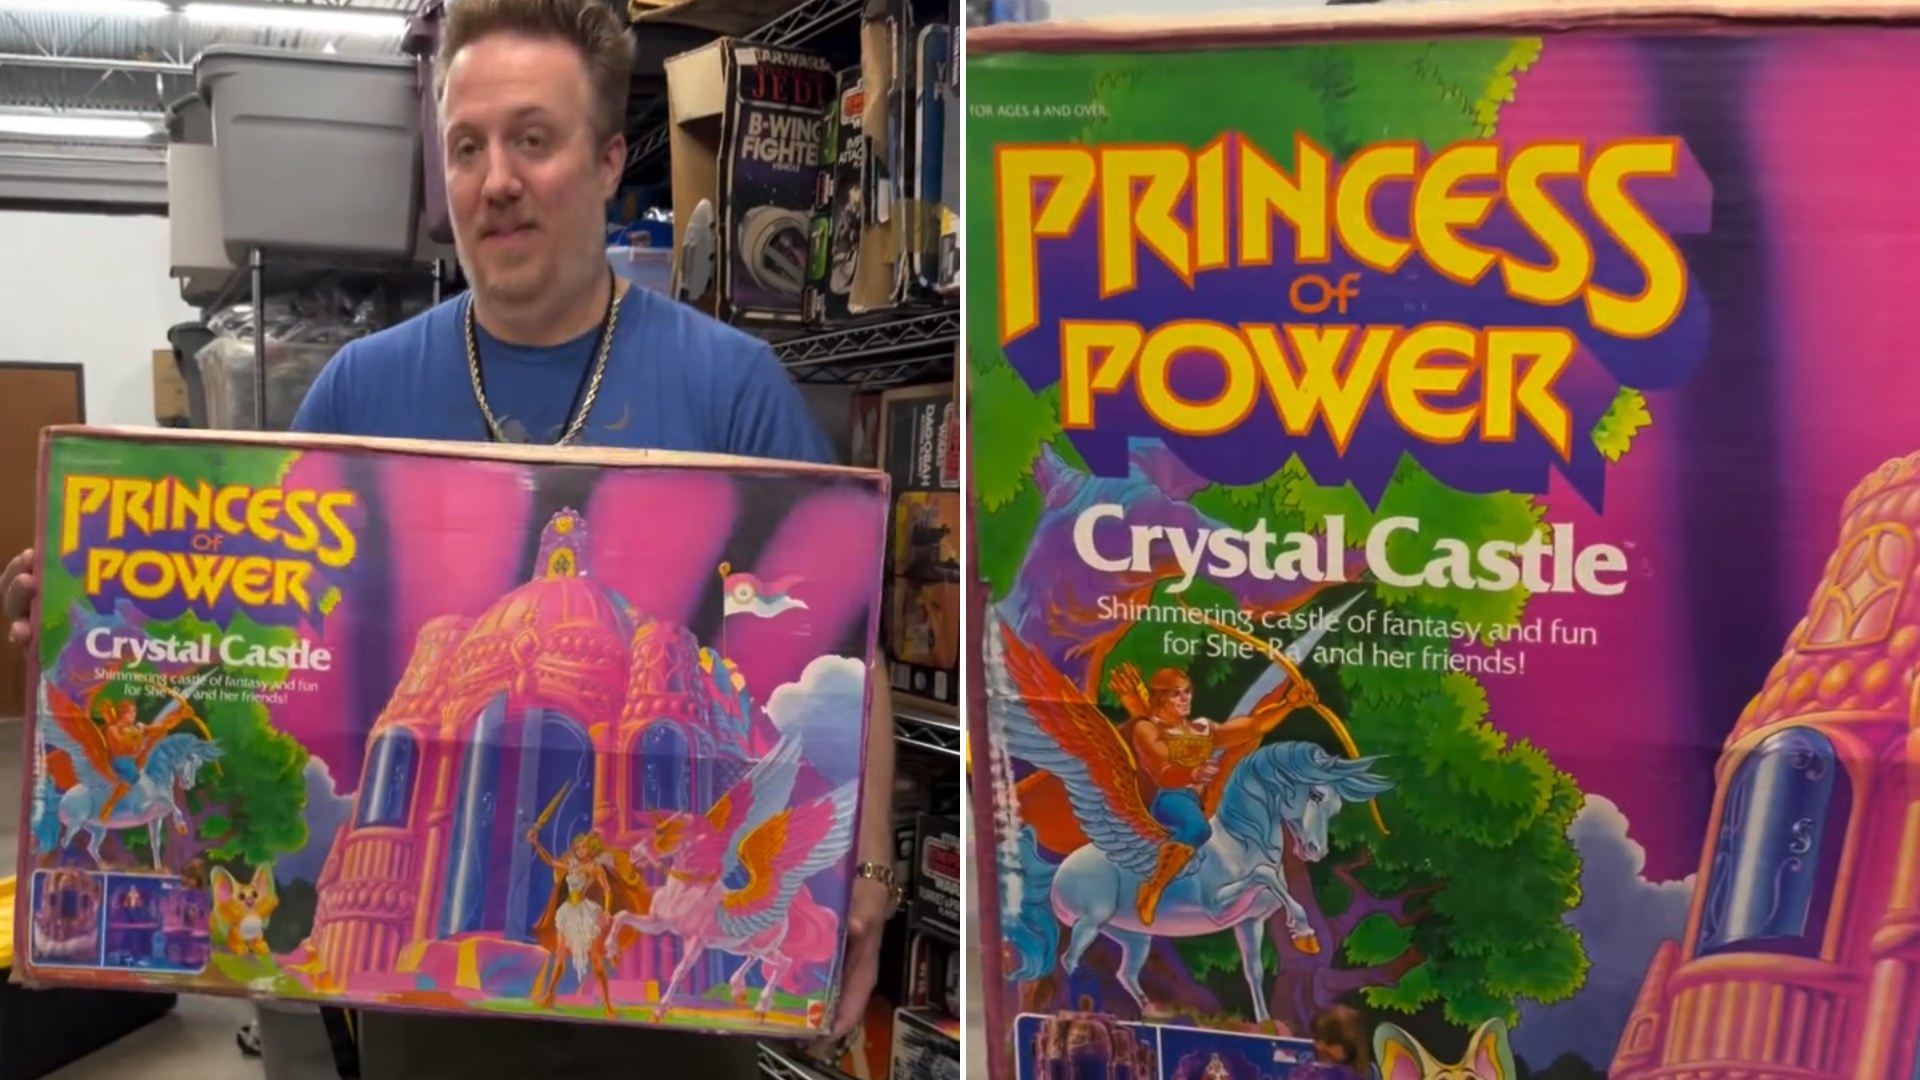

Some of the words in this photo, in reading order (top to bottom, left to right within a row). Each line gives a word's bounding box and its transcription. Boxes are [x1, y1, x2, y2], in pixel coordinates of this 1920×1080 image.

[752, 66, 825, 107] JEDI
[969, 104, 993, 117] FOR
[997, 104, 1030, 117] AGES
[1032, 104, 1040, 117] 4
[1043, 104, 1071, 117] AND
[741, 135, 819, 167] FIGHTE
[994, 130, 1687, 347] PRINCESS
[1060, 319, 1572, 463] POWER
[920, 404, 936, 487] DAGOBAH
[61, 474, 357, 567] PRINCESS
[1073, 503, 1347, 594] Crystal
[1366, 516, 1628, 595] Castle
[86, 547, 312, 613] POWER
[1097, 596, 1254, 633] Shimmering
[1261, 605, 1341, 632] castle
[1347, 608, 1380, 634] of
[1382, 611, 1482, 647] fantasy
[1491, 620, 1543, 645] and
[1550, 619, 1598, 646] fun
[85, 627, 211, 669] Crystal
[219, 634, 332, 671] Castle
[1163, 632, 1203, 656] for
[1313, 644, 1365, 667] and
[1372, 646, 1418, 669] her
[1422, 647, 1525, 675] friends!
[94, 667, 167, 686] Shimmering
[170, 671, 207, 685] castle
[209, 672, 224, 685] of
[224, 675, 270, 692] fantasy
[271, 678, 296, 691] and
[297, 678, 319, 692] fun
[124, 682, 142, 696] for
[192, 688, 216, 700] and
[219, 688, 240, 701] her
[241, 690, 288, 705] friends!
